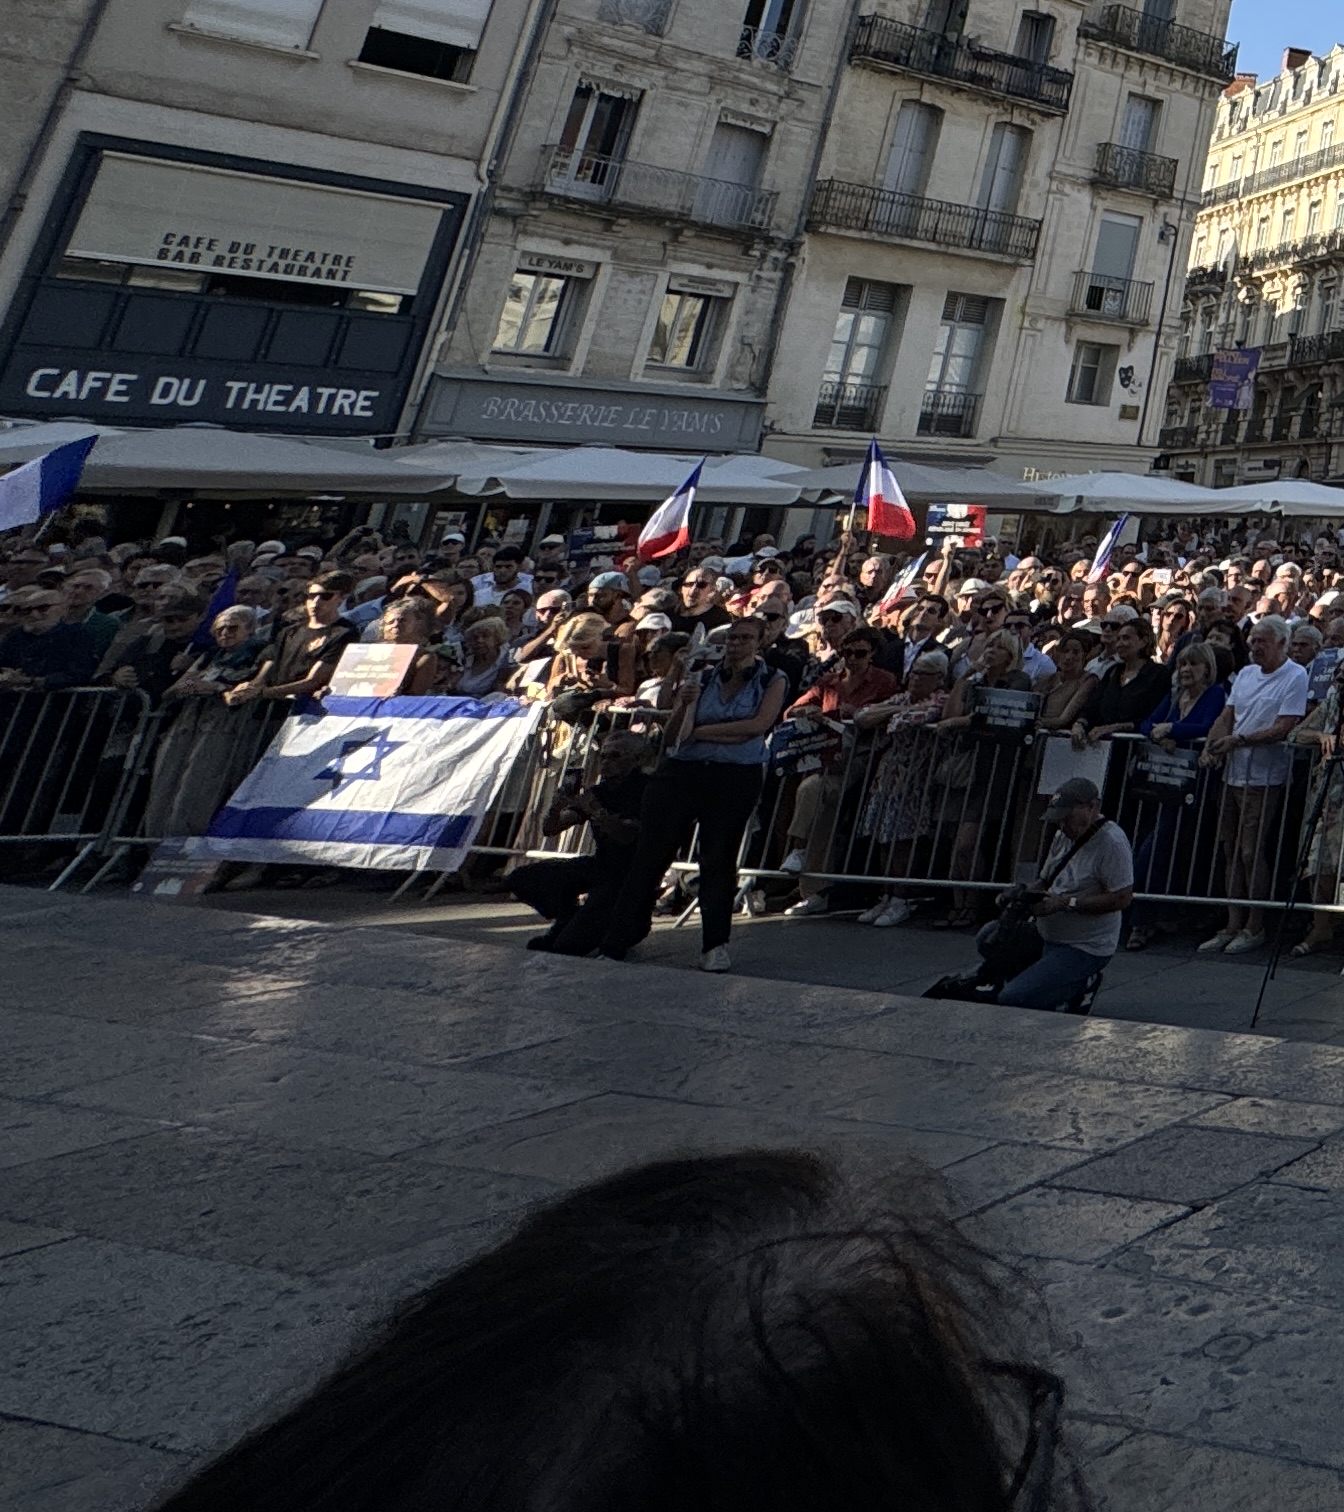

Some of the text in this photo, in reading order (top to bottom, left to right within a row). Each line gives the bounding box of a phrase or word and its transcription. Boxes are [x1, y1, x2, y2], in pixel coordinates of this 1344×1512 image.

[156, 247, 351, 282] BAR RESTAURANT
[162, 232, 356, 268] CAFE DU THEATRE
[527, 256, 585, 274] LE YAM'S
[26, 368, 380, 417] CAFE DU THEATRE
[481, 396, 622, 427] BRASSERIE
[622, 407, 657, 430] LE
